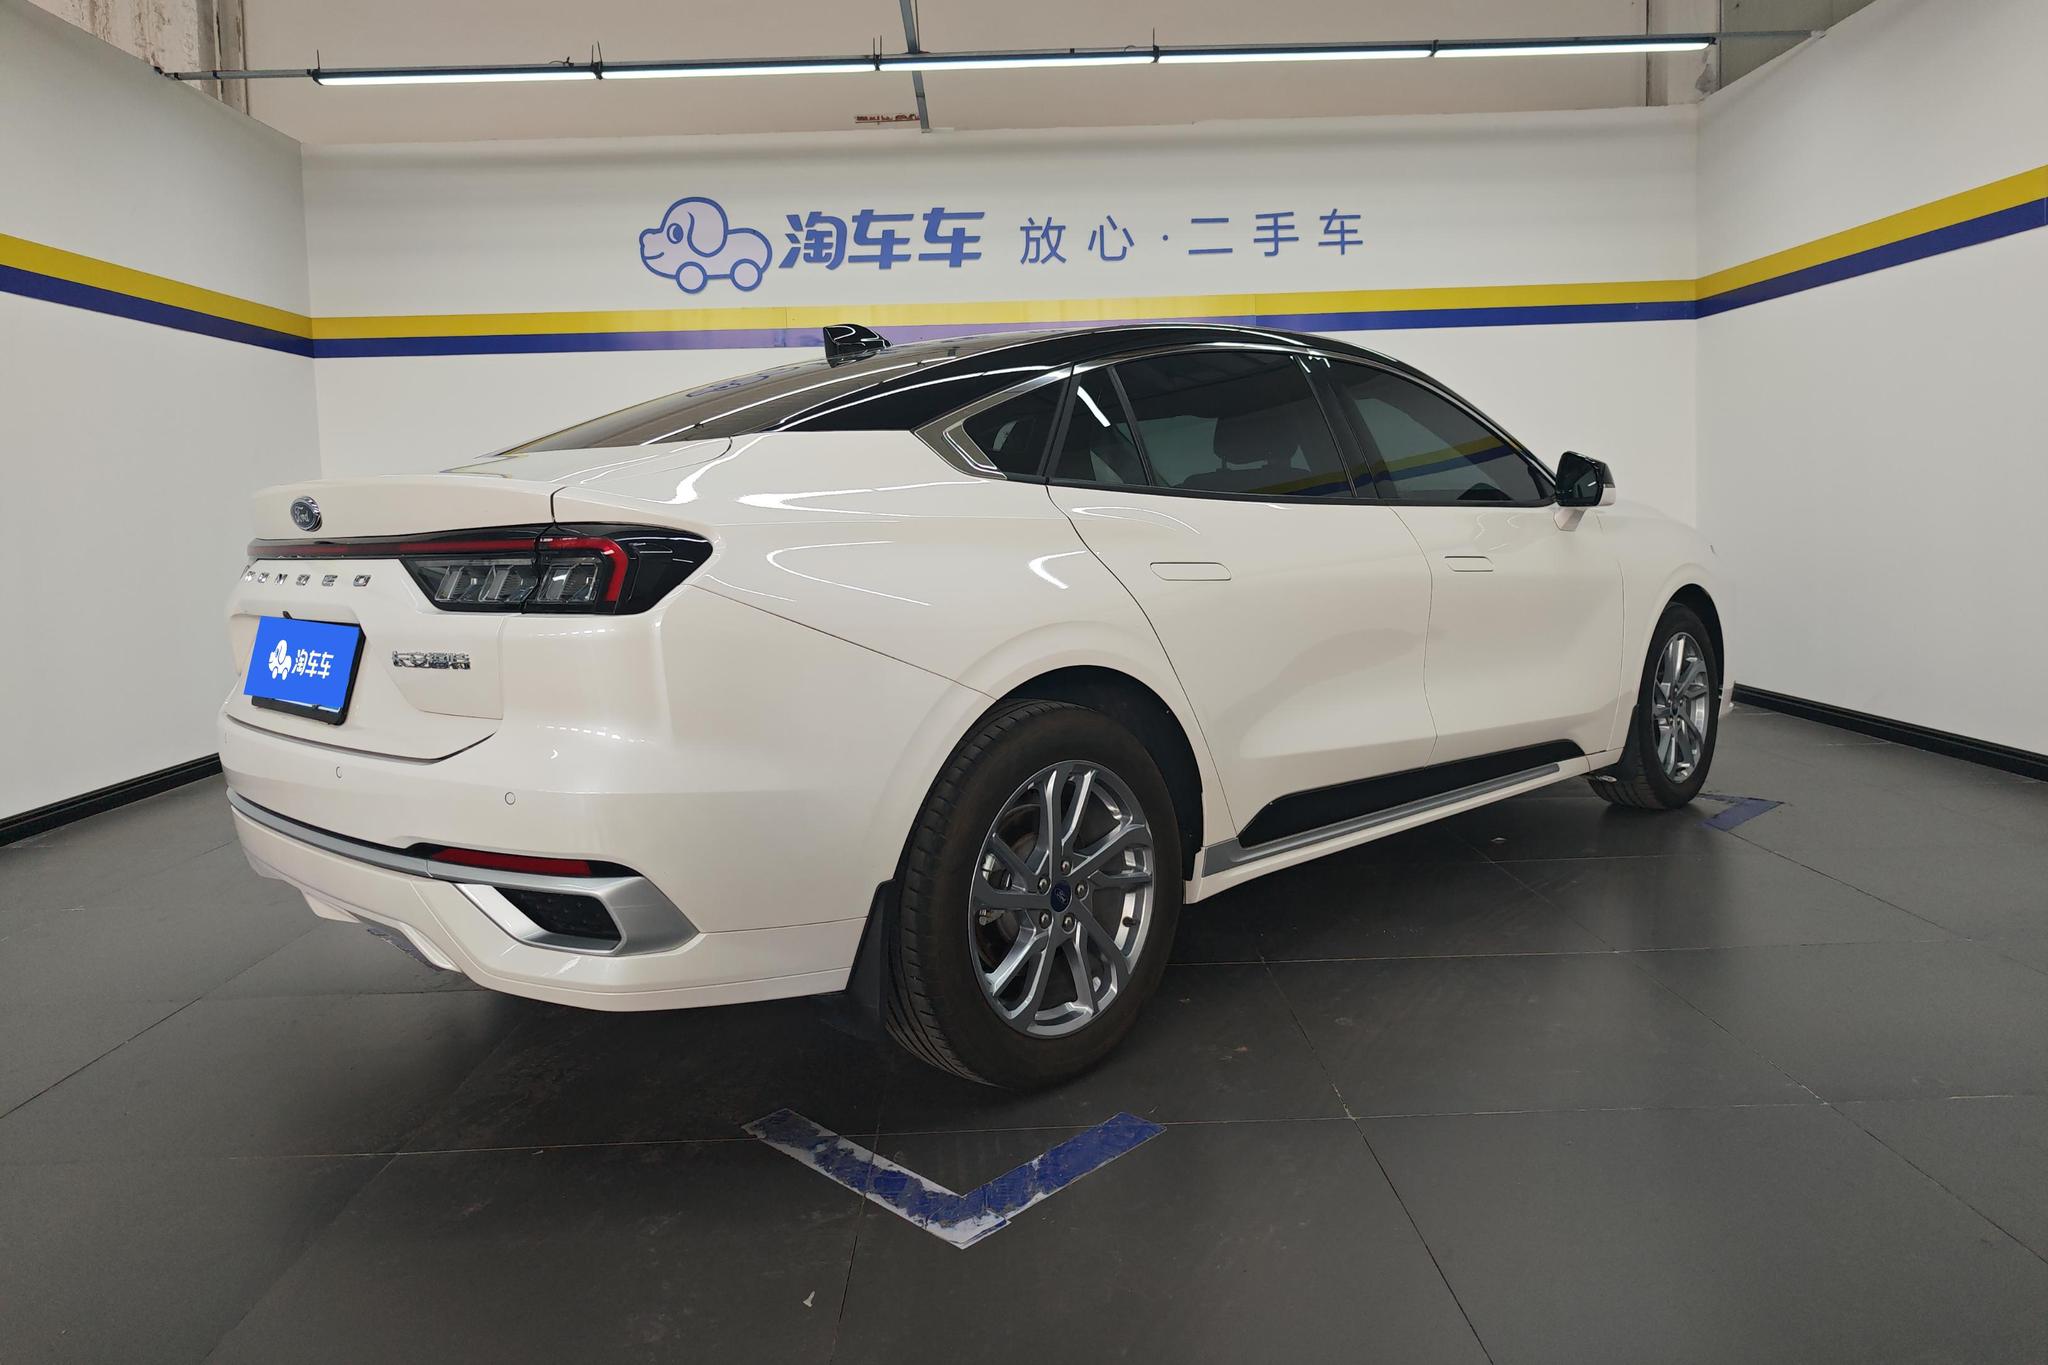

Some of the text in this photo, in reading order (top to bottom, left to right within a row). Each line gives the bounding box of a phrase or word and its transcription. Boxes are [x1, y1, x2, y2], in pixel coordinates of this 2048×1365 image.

[779, 208, 984, 270] 淘车车
[291, 648, 334, 679] 淘车车
